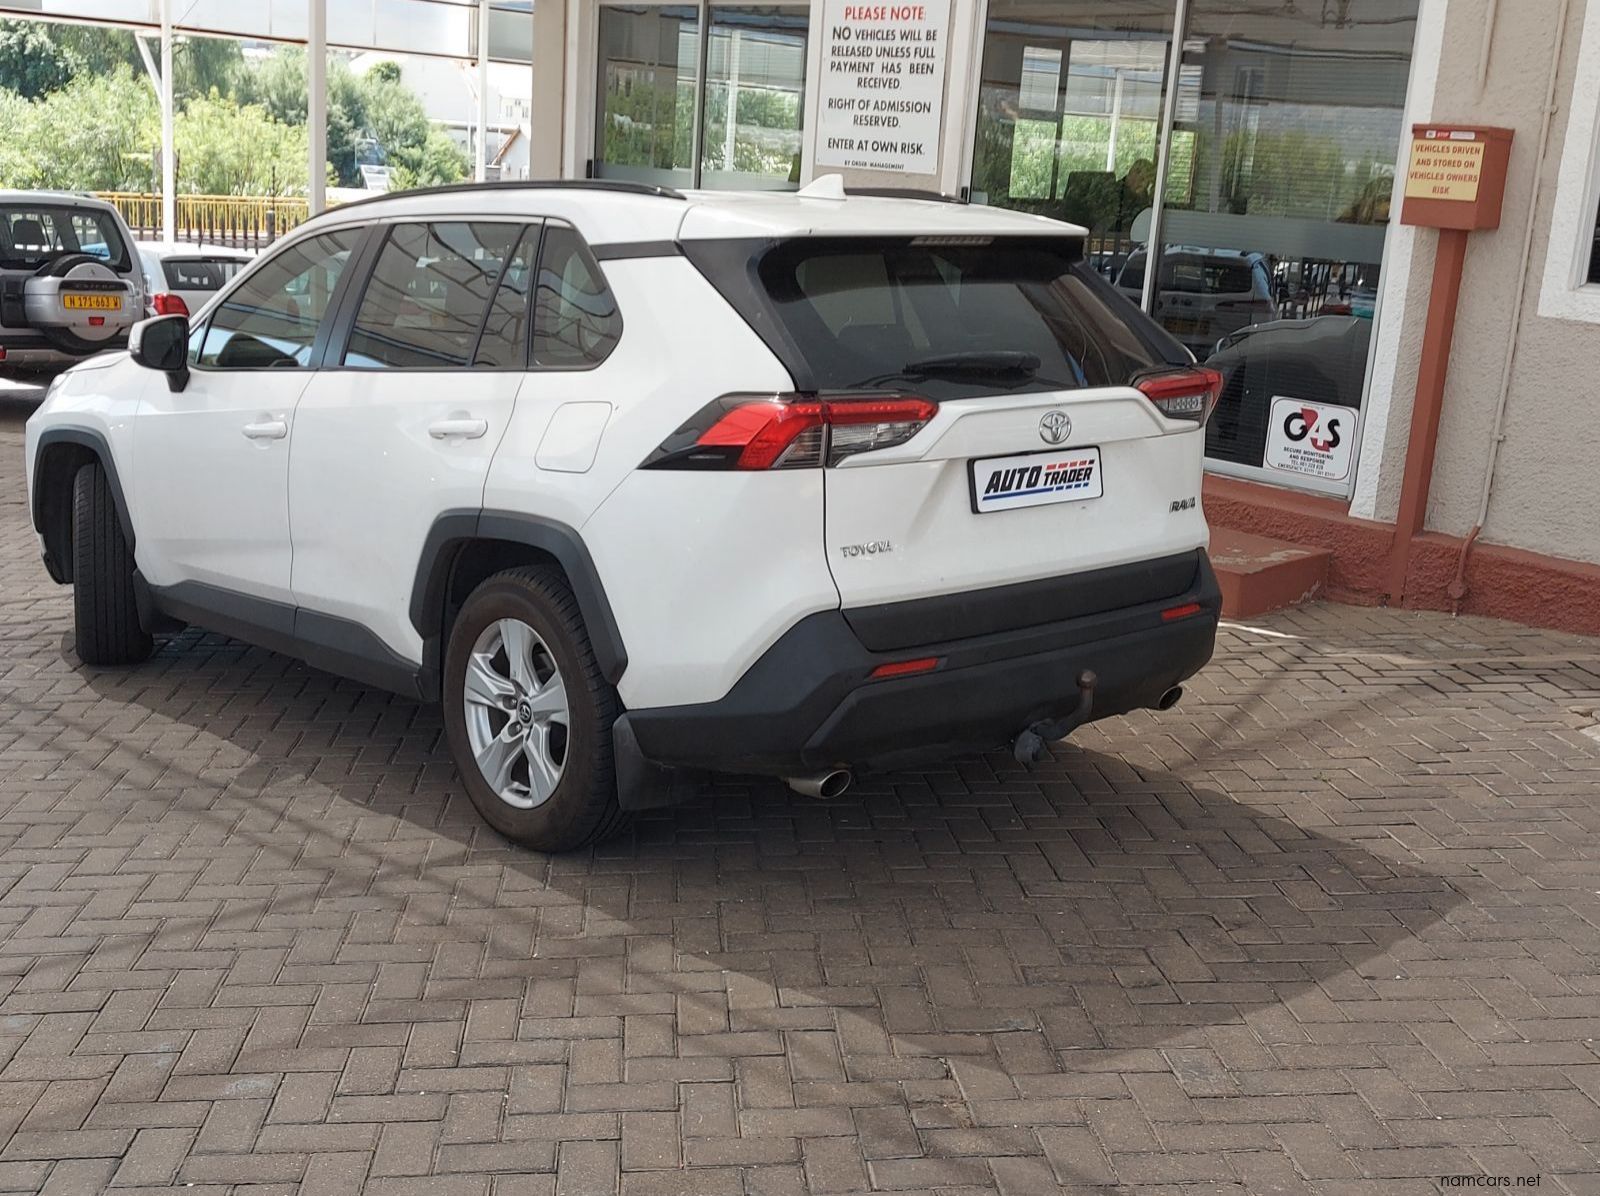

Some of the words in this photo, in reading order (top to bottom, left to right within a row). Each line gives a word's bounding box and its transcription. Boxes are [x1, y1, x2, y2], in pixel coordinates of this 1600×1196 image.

[845, 6, 886, 20] PLEASE
[832, 26, 851, 40] NO
[855, 29, 896, 41] VEHICLES
[900, 29, 922, 41] WILL
[926, 30, 937, 41] BE
[831, 46, 873, 57] RELEASED
[876, 46, 911, 58] UNLESS
[914, 47, 935, 58] FULL
[830, 61, 874, 73] PAYMENT
[881, 62, 902, 74] HAS
[909, 63, 934, 74] BEEN
[857, 77, 902, 90] RECEIVED.
[828, 98, 855, 110] RIGHT
[858, 99, 870, 111] OF
[873, 100, 931, 113] ADMISSION
[853, 115, 901, 128] RESERVED.
[828, 137, 854, 150] ENTER
[857, 140, 868, 151] AT
[871, 141, 898, 153] OWN
[901, 143, 925, 155] RISK.
[1415, 144, 1450, 153] VEHICLES
[1452, 146, 1480, 155] DRIVEN
[870, 162, 904, 170] MANAGEMENT
[1416, 158, 1431, 166] AND
[1433, 159, 1462, 168] STORED
[1410, 172, 1444, 181] VEHICLES
[1446, 174, 1478, 182] OWNERS
[1432, 186, 1450, 194] RISK
[1284, 408, 1340, 452] G4S
[1284, 446, 1302, 454] SECURE
[1303, 449, 1334, 460] MONITORING
[1300, 456, 1325, 464] RESPONSE
[985, 466, 1043, 494] AUTO
[1043, 466, 1093, 486] TRADER
[840, 540, 892, 558] TOYOTA
